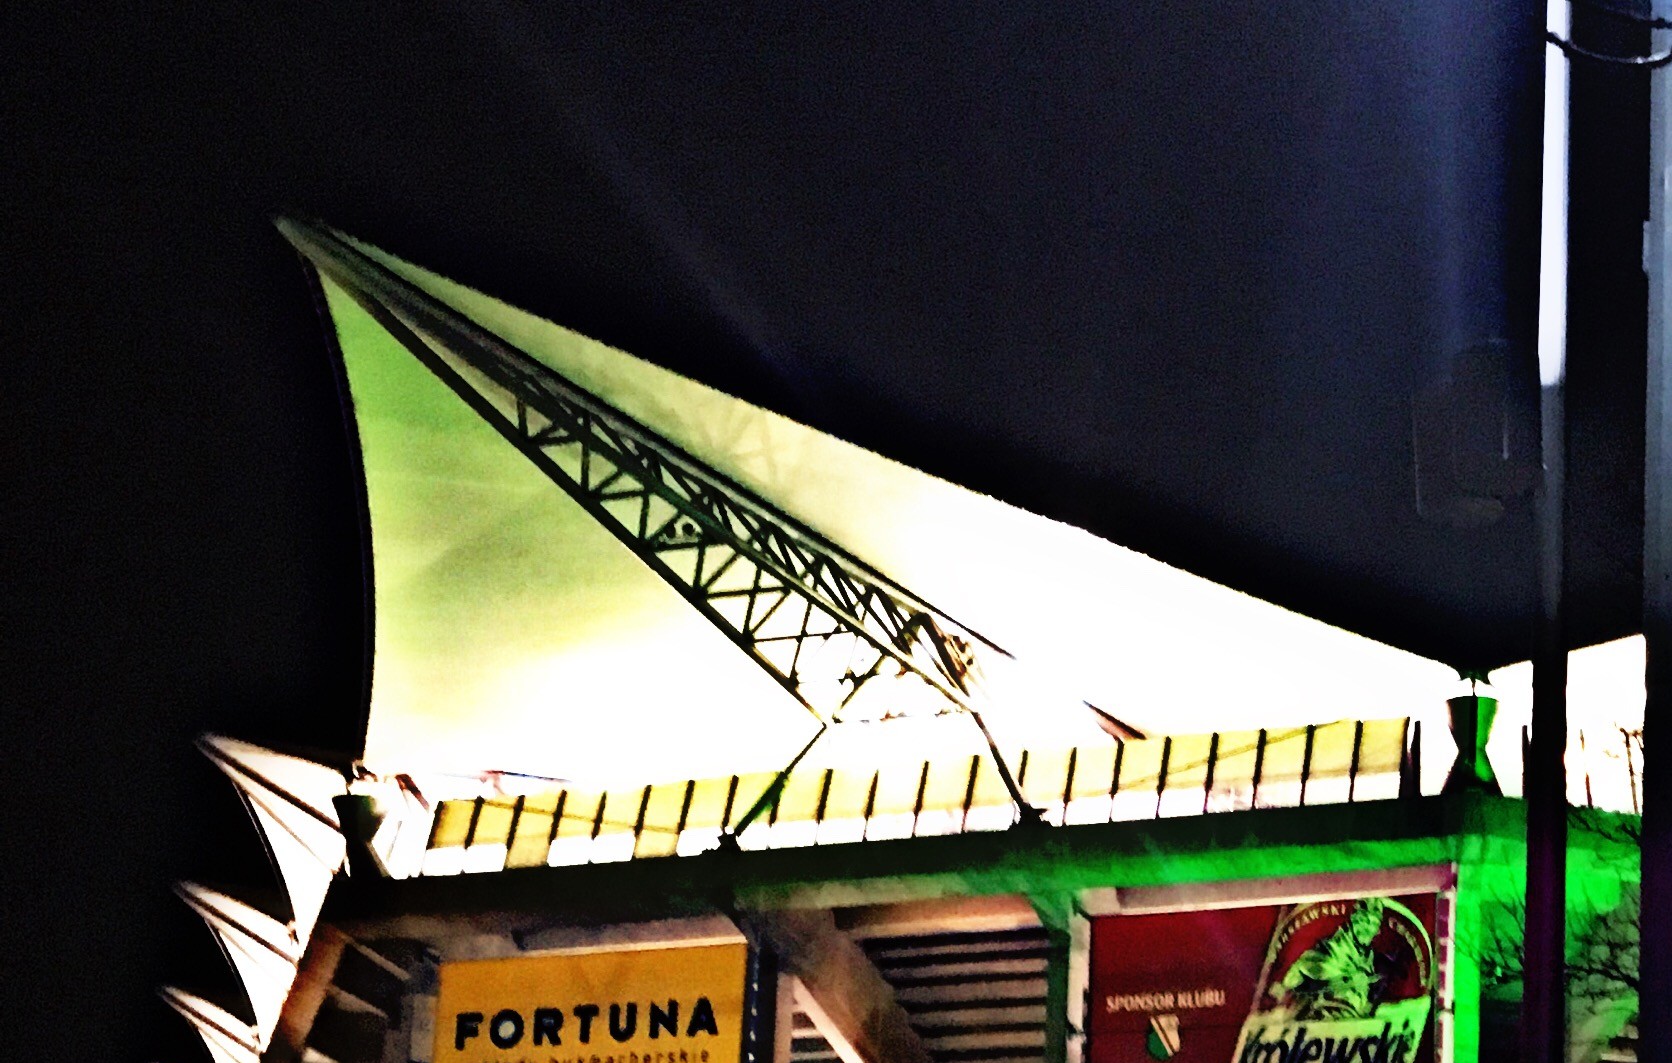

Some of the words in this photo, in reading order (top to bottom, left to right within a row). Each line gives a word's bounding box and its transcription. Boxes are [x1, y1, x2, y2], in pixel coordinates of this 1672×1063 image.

[1106, 991, 1175, 1014] SPONSOR
[1177, 987, 1226, 1009] KLUBU
[455, 996, 719, 1050] FORTUNA
